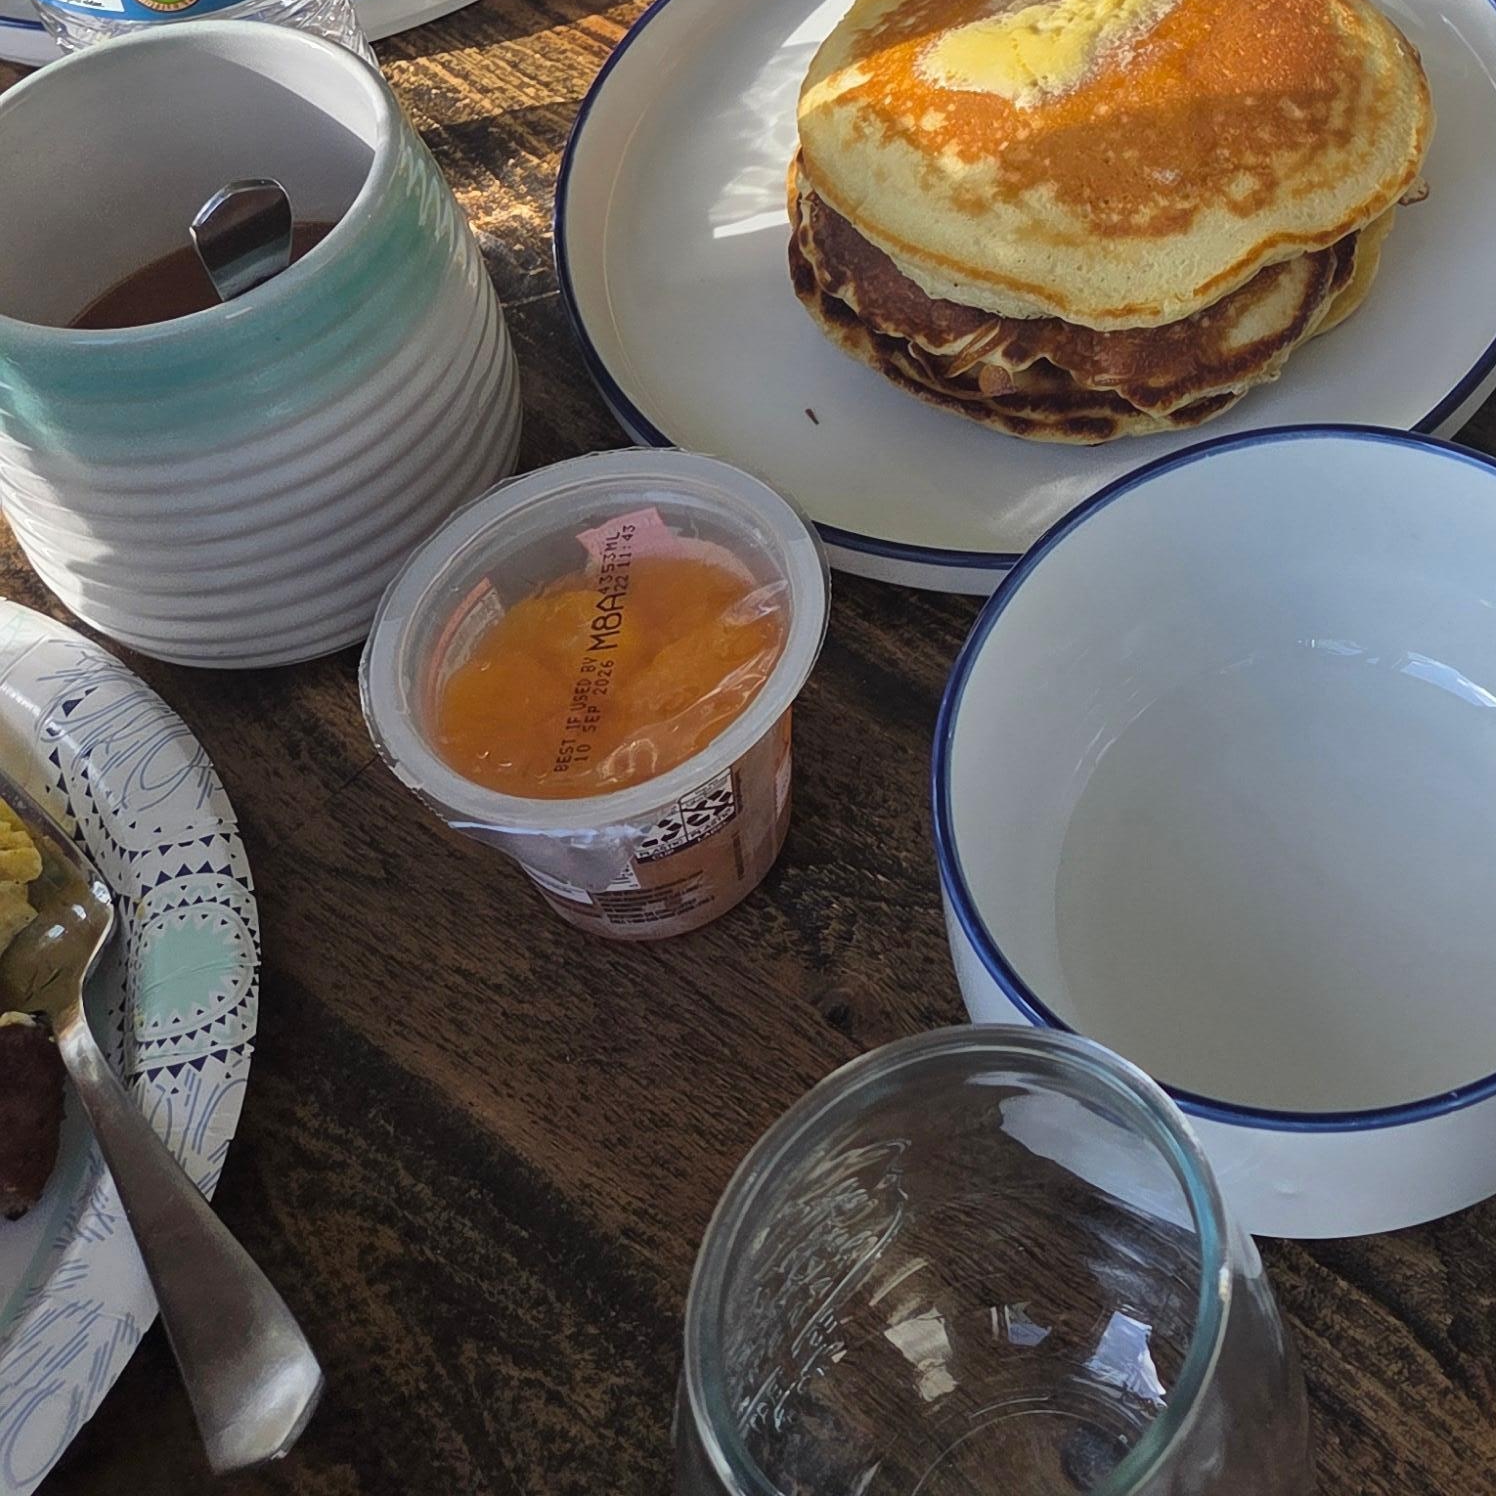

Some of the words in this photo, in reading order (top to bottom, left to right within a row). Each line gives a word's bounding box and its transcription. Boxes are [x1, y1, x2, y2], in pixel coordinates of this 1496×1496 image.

[587, 591, 627, 651] M8A
[581, 656, 598, 674] BY
[592, 659, 615, 696] 2026
[572, 677, 593, 712] USED
[566, 715, 582, 731] IF
[582, 705, 601, 733] SEP
[553, 739, 576, 772] BEST
[574, 743, 592, 762] 10
